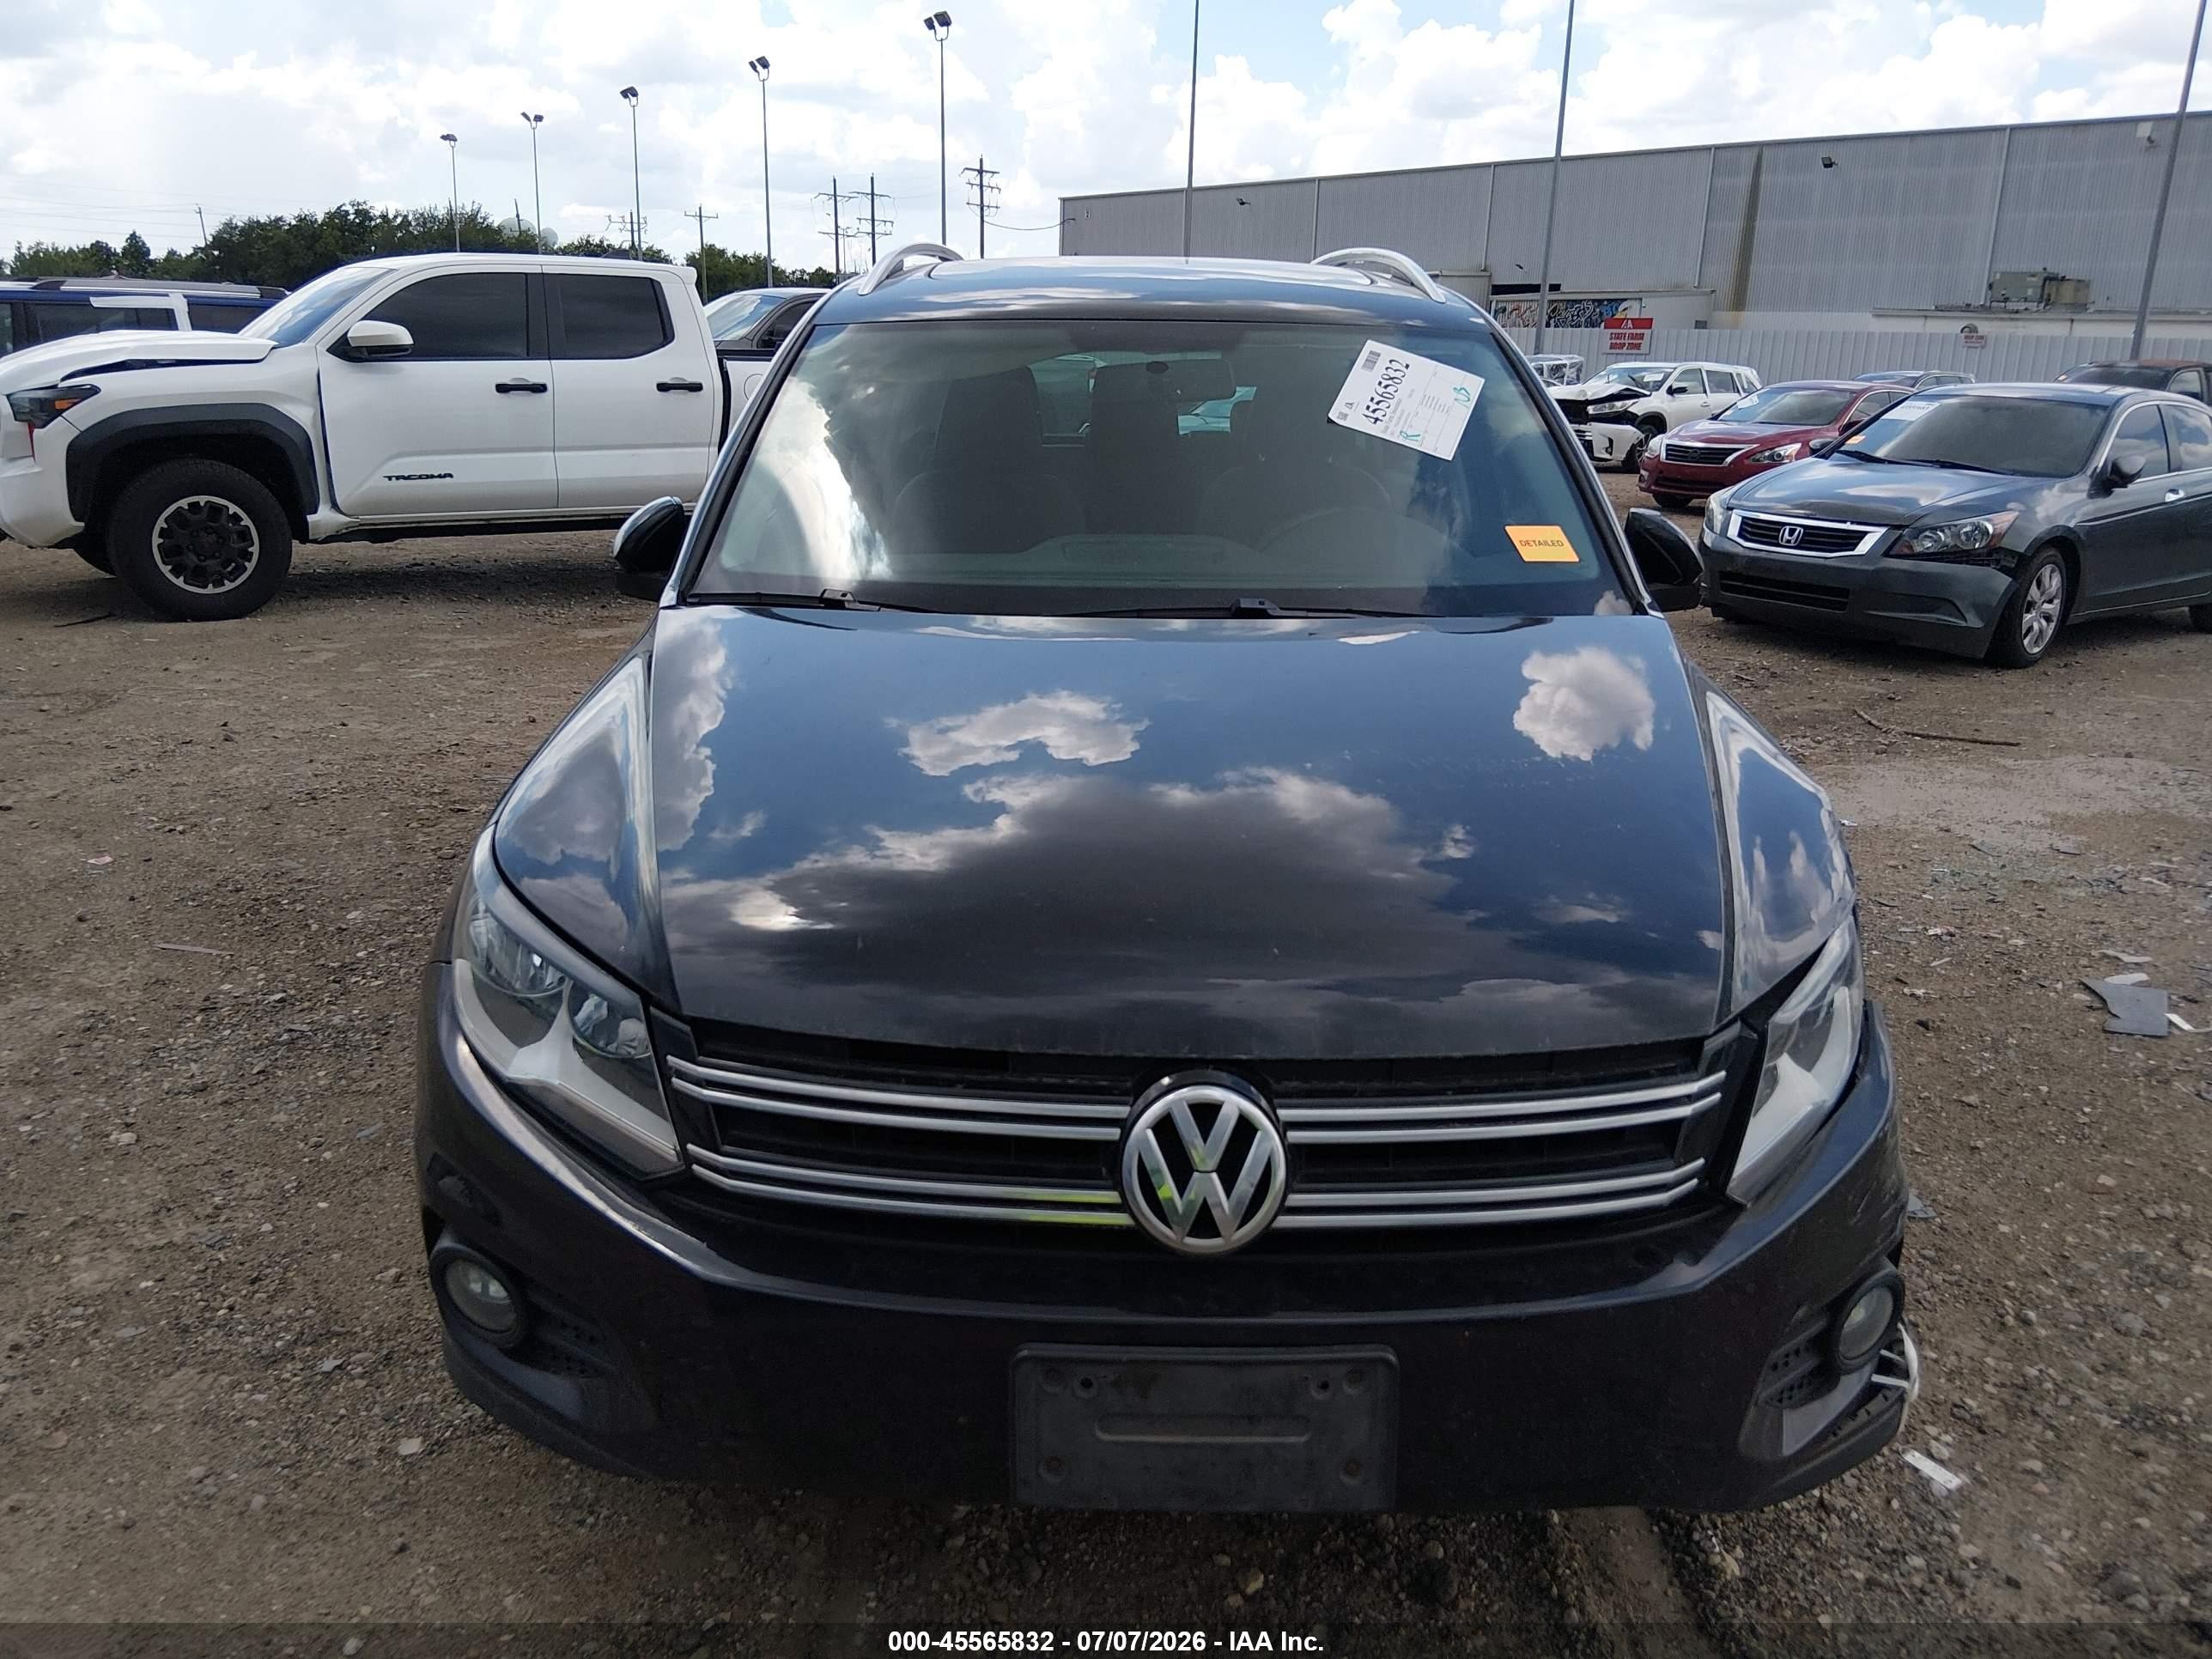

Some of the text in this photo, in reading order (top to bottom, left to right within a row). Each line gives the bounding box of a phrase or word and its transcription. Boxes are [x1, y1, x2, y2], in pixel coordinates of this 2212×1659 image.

[1362, 358, 1411, 425] 45565832
[382, 472, 454, 482] TACOMA
[1518, 539, 1565, 548] DETAILED
